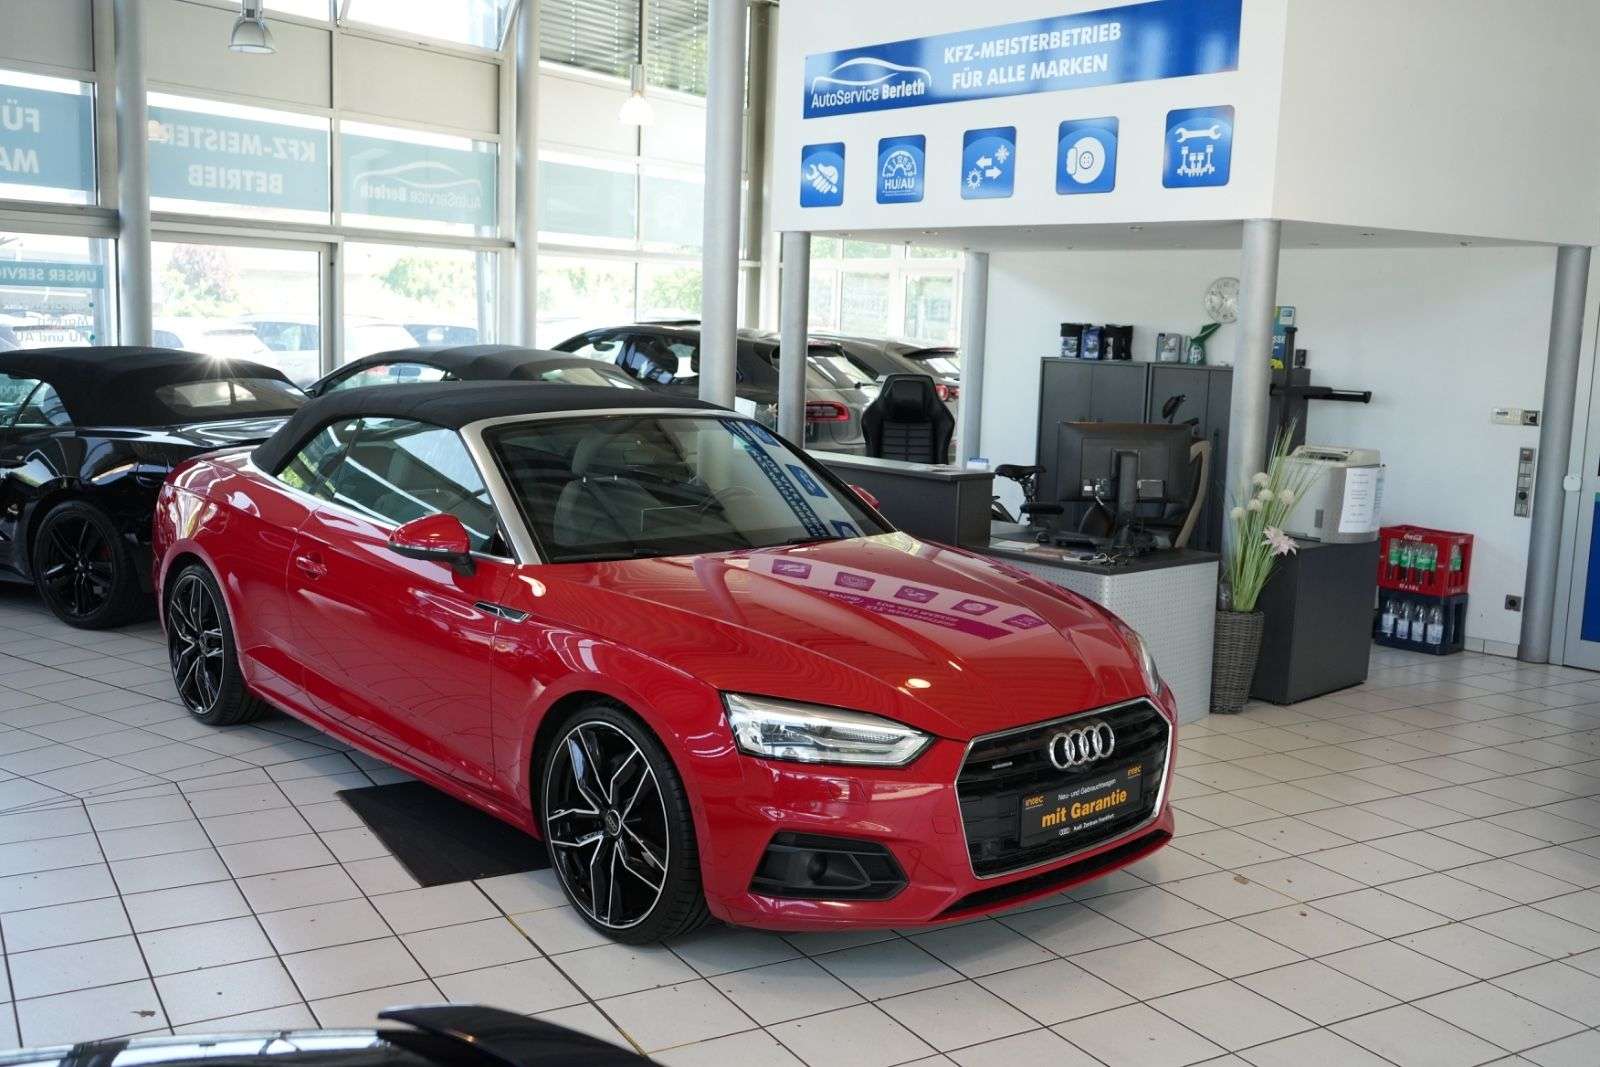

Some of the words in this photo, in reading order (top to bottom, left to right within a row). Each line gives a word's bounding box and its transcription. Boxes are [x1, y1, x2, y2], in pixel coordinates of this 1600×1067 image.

[944, 22, 1121, 64] KFZ-MEISTERBETRIEB
[951, 66, 983, 90] FÜR
[987, 63, 1026, 86] ALLE
[1030, 53, 1109, 81] MARKEN
[811, 86, 879, 109] AutoService
[881, 78, 925, 100] Berleth
[884, 177, 915, 190] HU/AU
[1041, 806, 1067, 828] mit
[1071, 789, 1128, 819] Garantie
